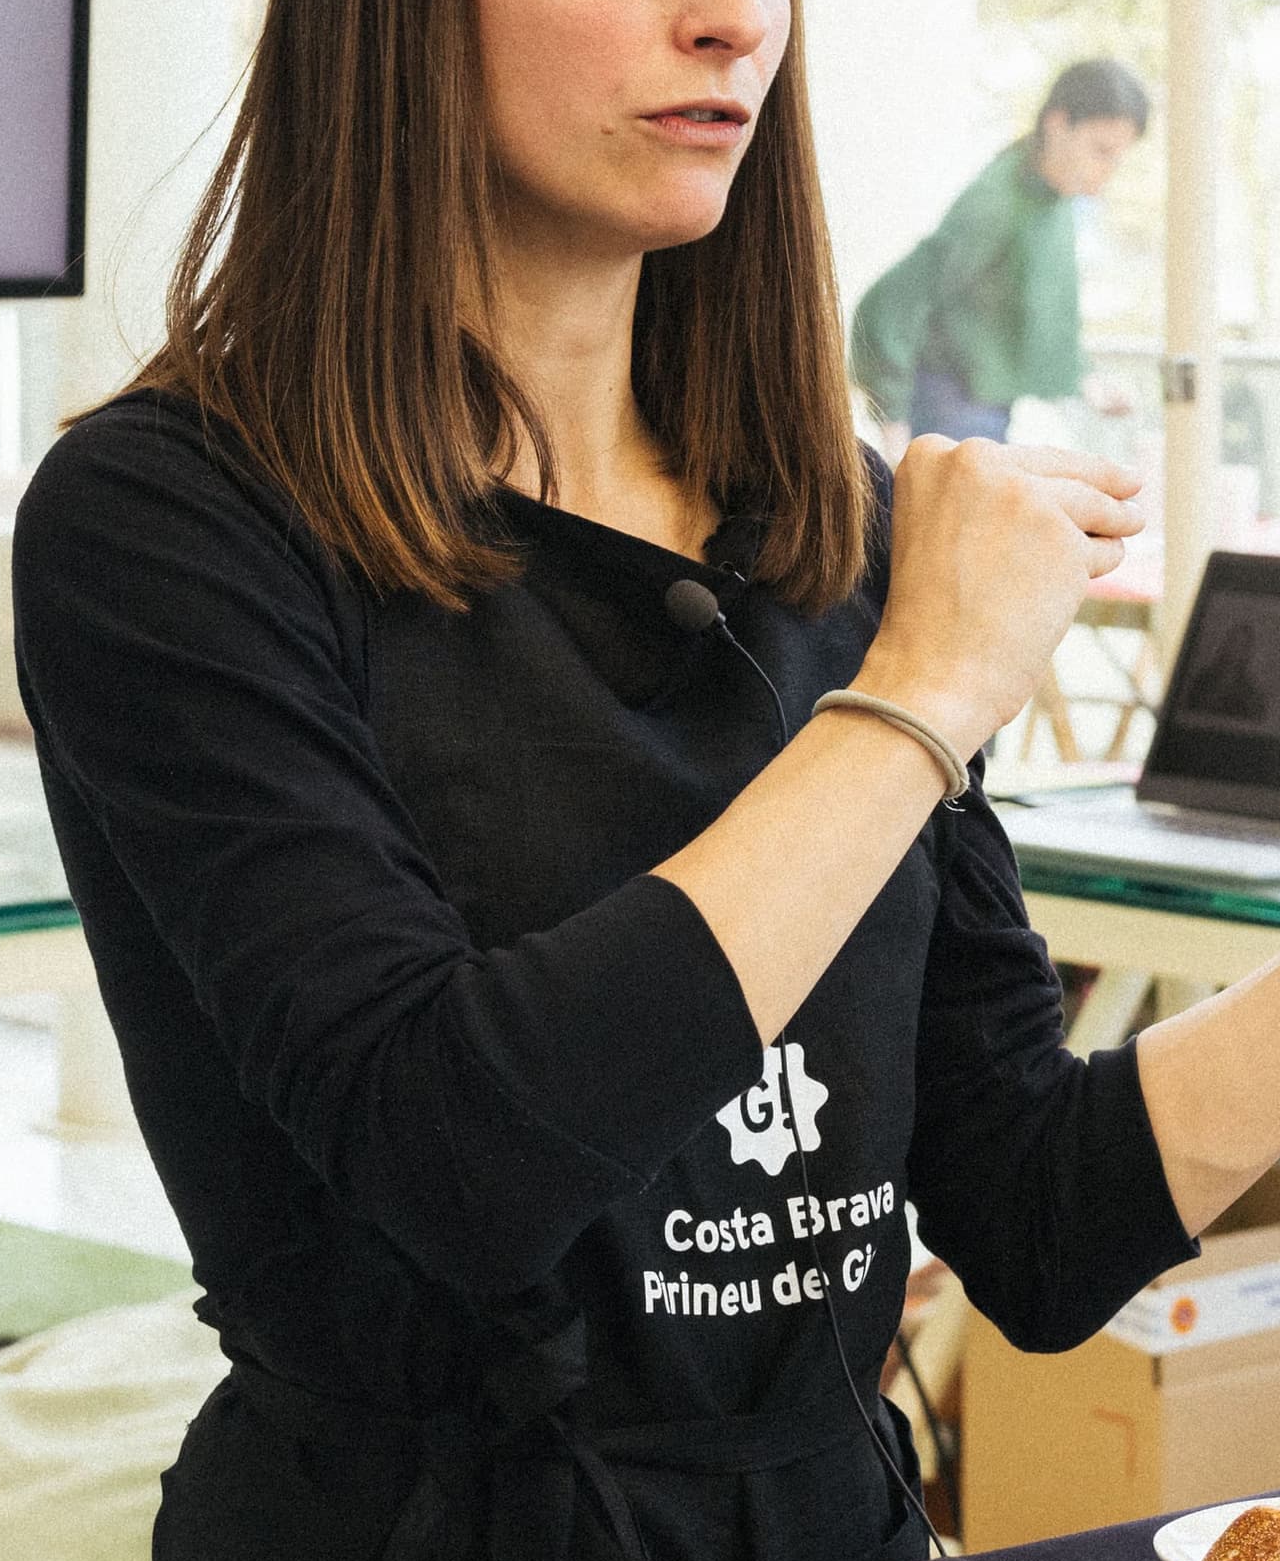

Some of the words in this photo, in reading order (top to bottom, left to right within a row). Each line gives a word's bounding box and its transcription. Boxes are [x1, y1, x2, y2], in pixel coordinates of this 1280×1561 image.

[664, 1206, 775, 1253] Costa
[786, 1181, 895, 1239] Brava
[643, 1269, 762, 1317] Pirineu
[772, 1261, 830, 1306] de
[841, 1242, 877, 1292] Gi
